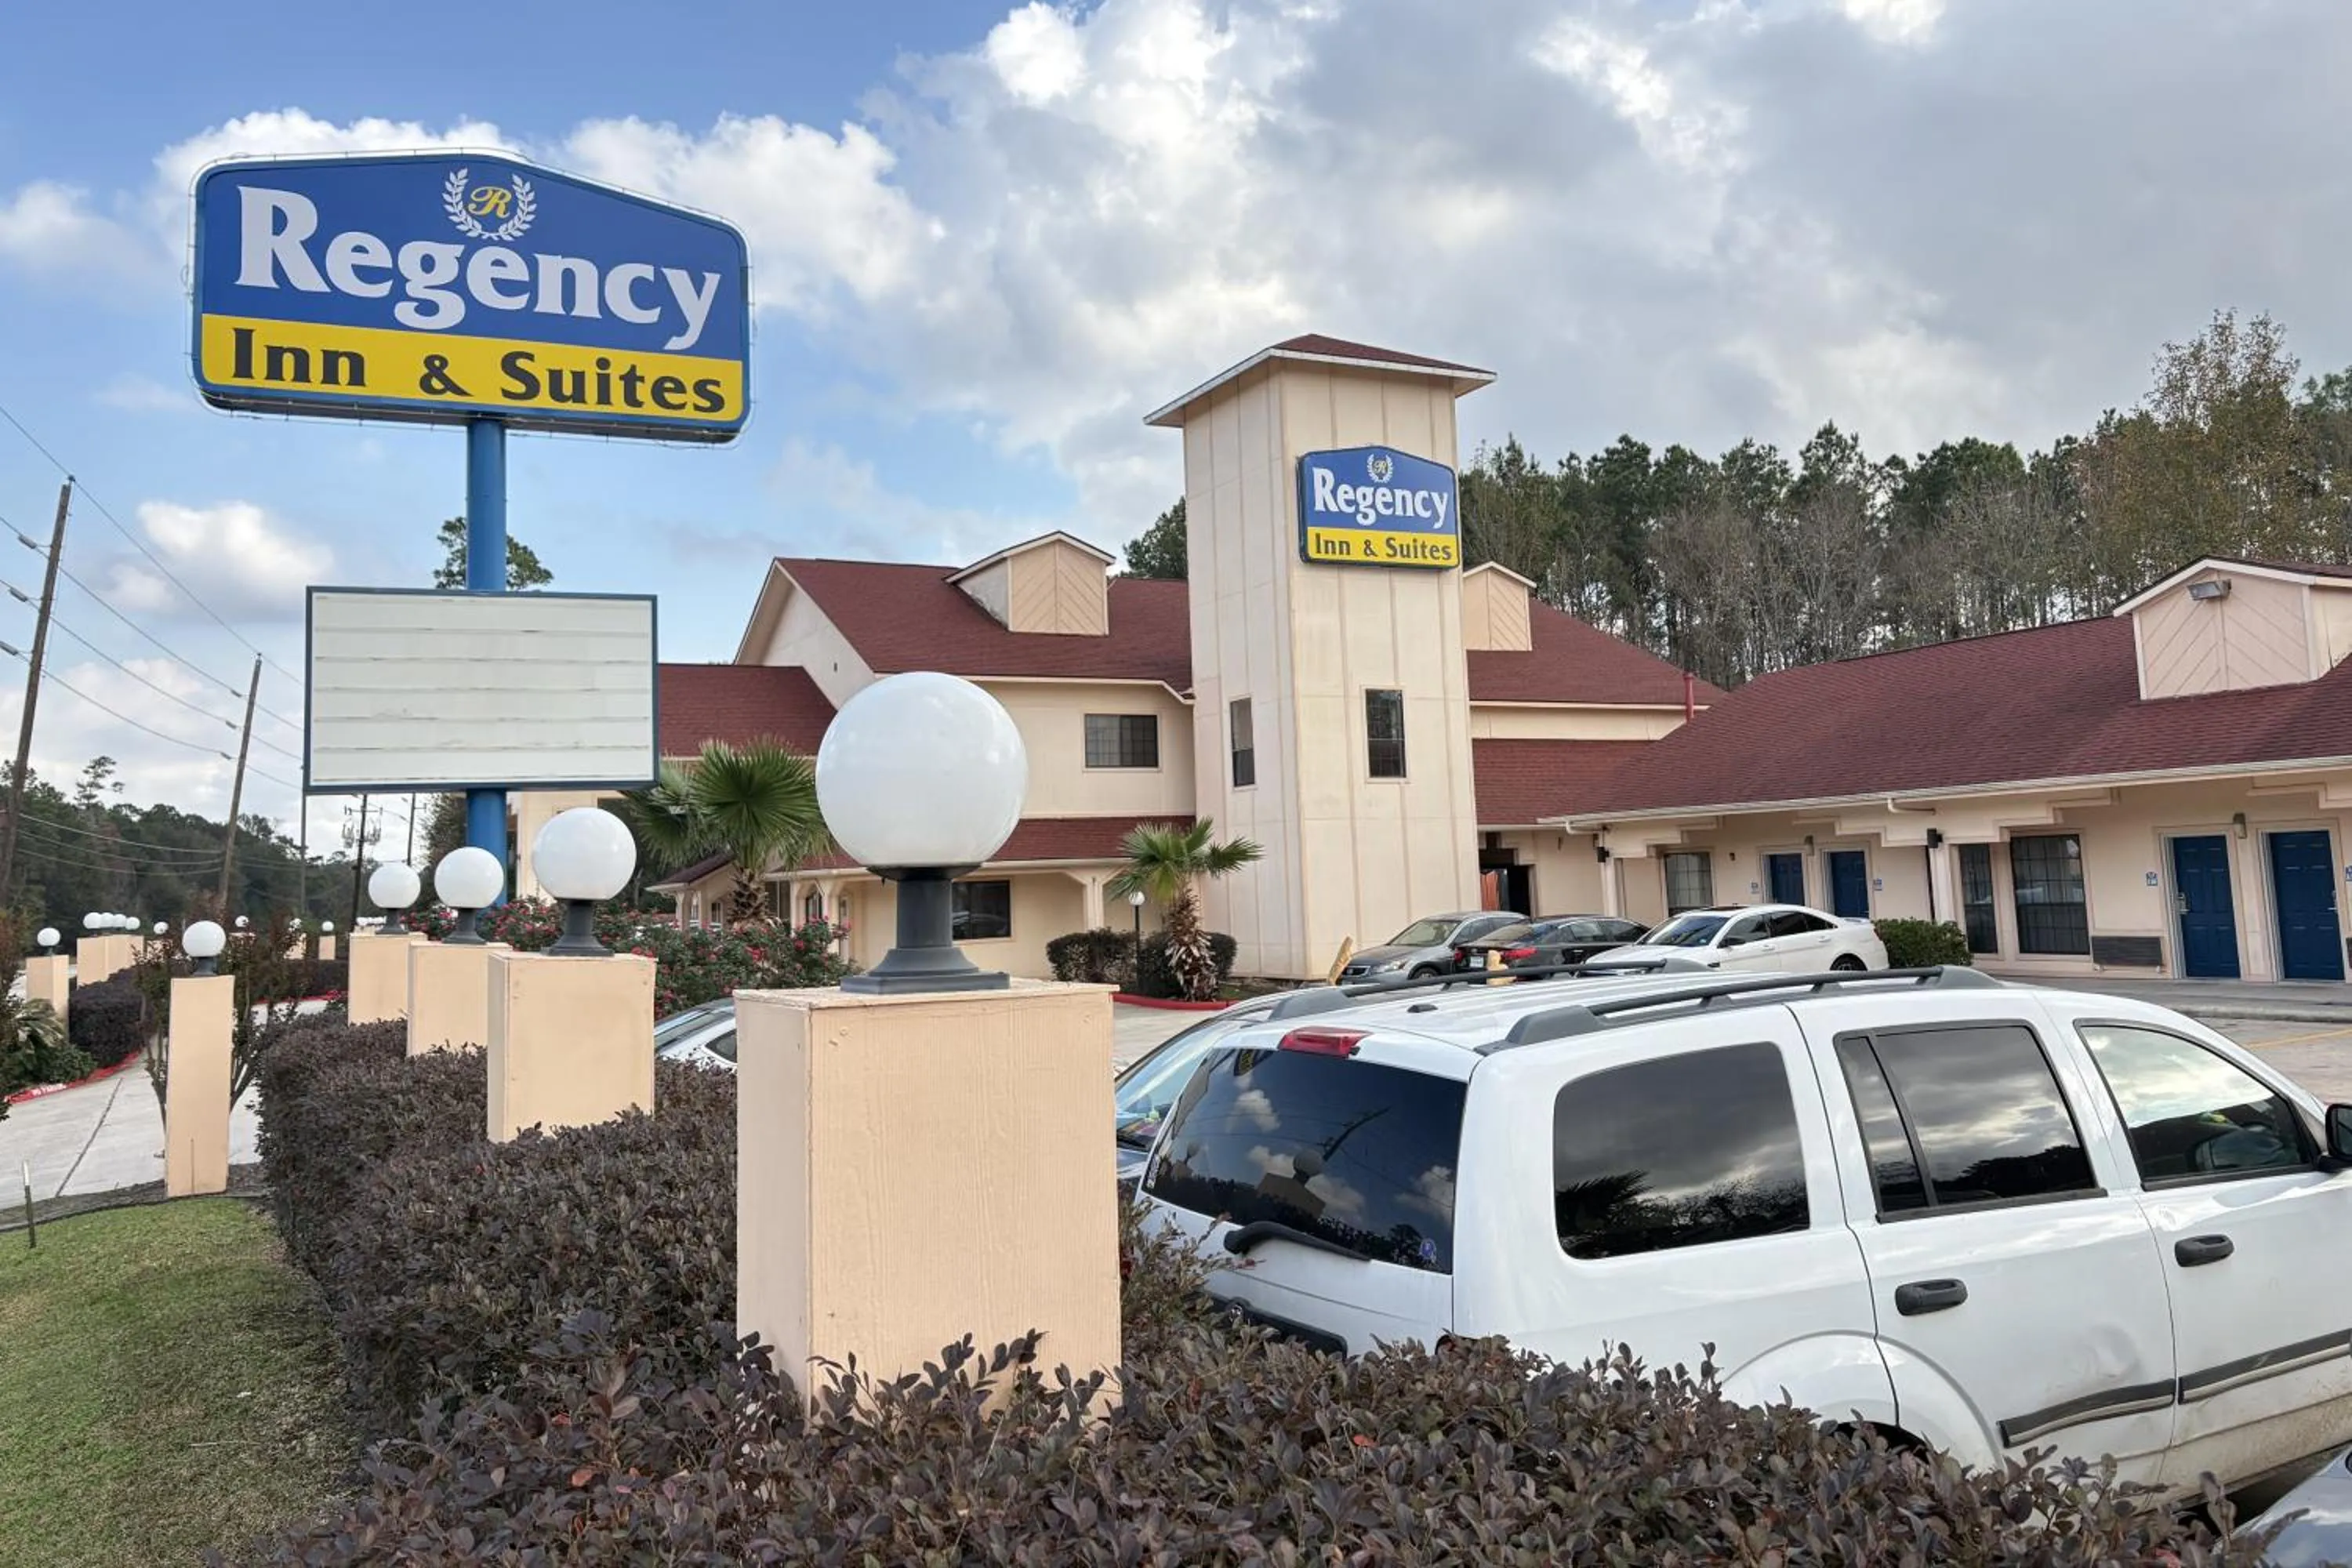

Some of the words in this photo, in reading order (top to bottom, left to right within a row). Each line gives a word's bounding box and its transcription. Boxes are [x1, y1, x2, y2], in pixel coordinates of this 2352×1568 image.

[235, 185, 721, 351] Regency
[231, 327, 366, 388] Inn
[419, 354, 473, 397] &
[499, 350, 726, 413] Suites
[1312, 466, 1449, 529] Regency
[1315, 532, 1351, 556] Inn
[1363, 539, 1378, 557] &
[1385, 537, 1452, 561] Suites
